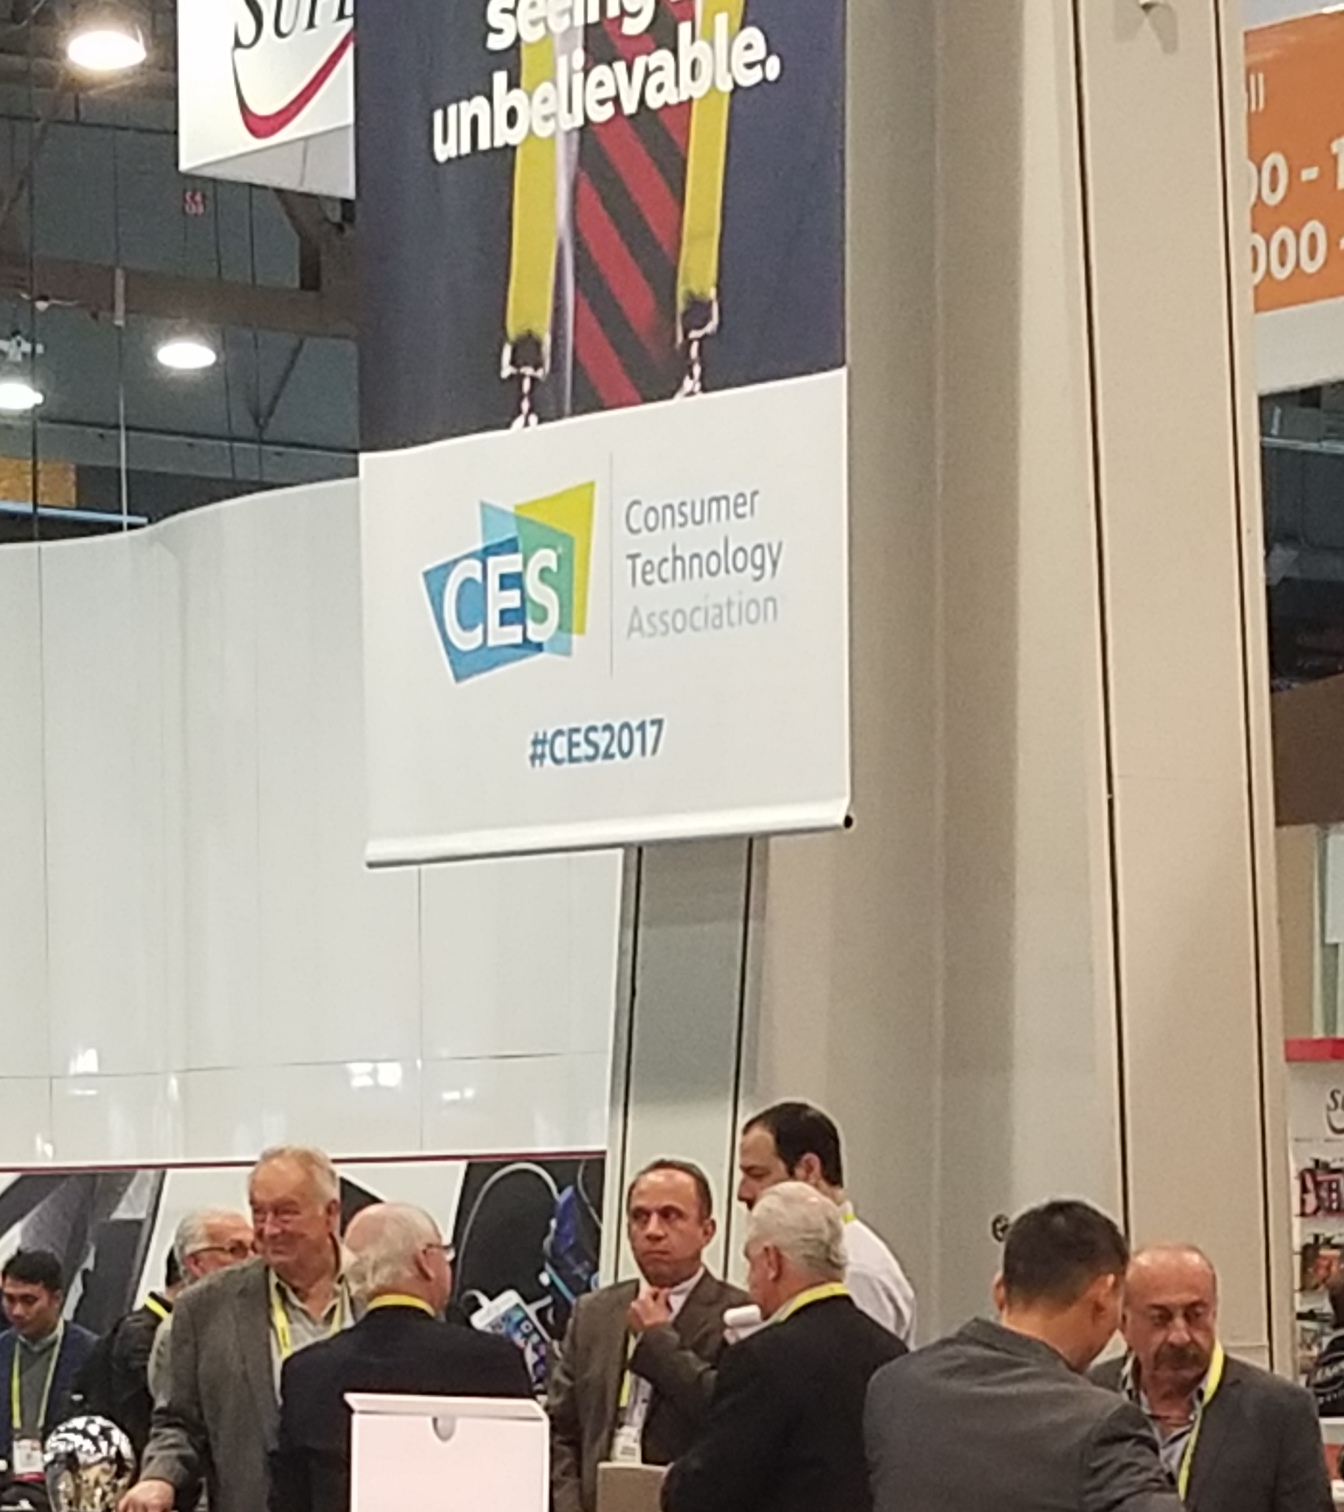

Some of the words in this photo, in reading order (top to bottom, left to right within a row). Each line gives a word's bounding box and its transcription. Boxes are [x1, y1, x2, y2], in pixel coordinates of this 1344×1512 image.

[433, 11, 781, 163] unbelievable.
[625, 489, 759, 535] Consumer
[626, 538, 783, 588] Technology
[442, 548, 560, 652] CES
[626, 593, 778, 640] Association
[529, 718, 666, 768] #CES2017
